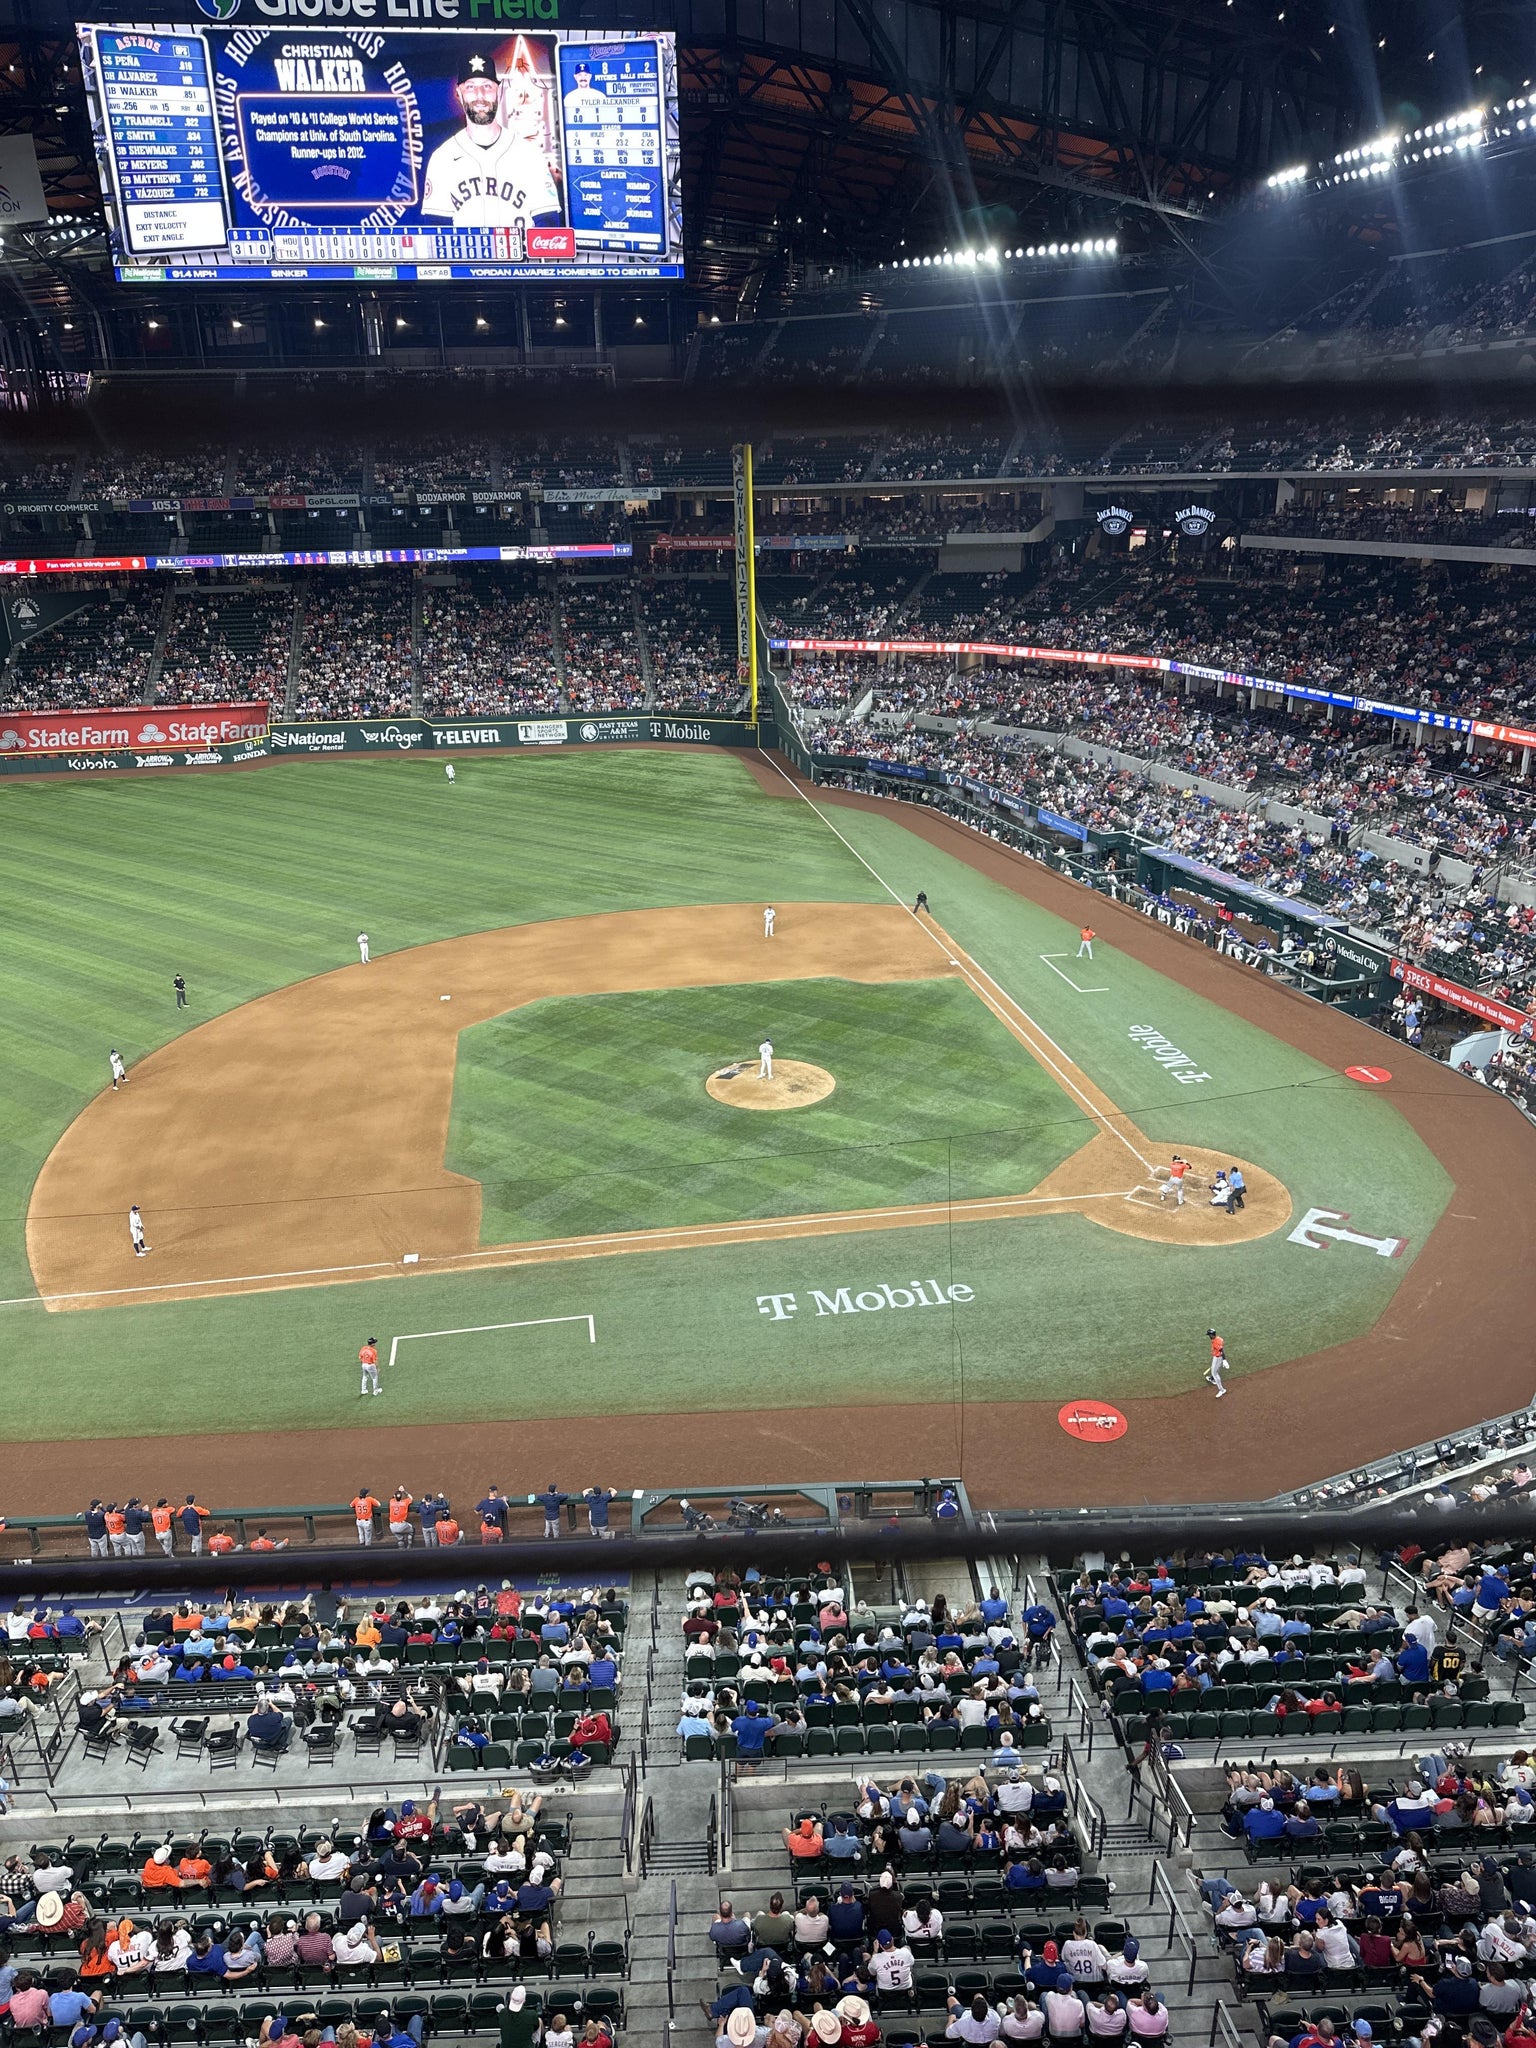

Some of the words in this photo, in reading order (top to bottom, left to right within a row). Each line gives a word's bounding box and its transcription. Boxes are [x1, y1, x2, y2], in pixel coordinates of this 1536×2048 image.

[254, 0, 377, 18] Globe
[386, 0, 460, 19] Life
[471, 0, 559, 20] Field
[115, 35, 161, 54] ASTROS
[281, 44, 353, 58] CHRISTIAN
[102, 56, 112, 65] SS
[115, 55, 140, 67] PEÑA
[118, 71, 158, 82] ALVAREZ
[273, 58, 366, 93] WALKER
[107, 86, 117, 95] 1B
[120, 87, 158, 97] WALKER
[122, 101, 138, 111] .256
[161, 103, 170, 112] 15
[196, 104, 205, 113] 40
[581, 98, 601, 106] TYLER
[602, 98, 641, 106] ALEXANDER
[124, 116, 174, 127] TRAMMELL
[251, 111, 277, 127] Played
[278, 115, 288, 125] on
[301, 112, 309, 125] &
[319, 111, 347, 127] College
[348, 112, 372, 125] World
[373, 113, 398, 126] Series
[126, 130, 156, 141] SMITH
[256, 129, 299, 144] Champions
[300, 130, 309, 142] at
[309, 129, 329, 142] Univ.
[329, 129, 338, 142] of
[339, 130, 361, 143] South
[362, 129, 397, 143] Carolina.
[129, 145, 177, 156] SHEWMAKE
[291, 146, 338, 160] Runner-ups
[339, 146, 346, 158] in
[347, 146, 366, 159] 2012.
[131, 160, 168, 170] MEYERS
[133, 174, 182, 184] MATTHEWS
[135, 187, 175, 198] VÁZQUEZ
[450, 176, 527, 211] ASTROS
[143, 210, 178, 219] DISTANCE
[136, 223, 152, 231] EXIT
[154, 221, 187, 230] VELOCITY
[143, 235, 160, 243] EXIT
[161, 233, 184, 242] ANGLE
[282, 237, 298, 246] HOU
[235, 244, 242, 255] 3
[260, 244, 266, 255] 0
[286, 249, 299, 258] TEX
[171, 270, 193, 279] 91.4
[193, 269, 218, 279] MPH
[271, 269, 309, 278] SINKER
[419, 269, 437, 277] LAST
[438, 269, 449, 277] AB
[469, 268, 513, 277] YORDAN
[512, 268, 557, 277] ALVAREZ
[557, 268, 605, 277] HOMERED
[606, 268, 620, 277] TO
[621, 268, 661, 277] CENTER
[308, 496, 357, 507] GoPGL.com
[369, 496, 392, 505] PGL
[416, 492, 466, 503] BODYARMOR
[472, 491, 522, 501] BODYARMOR
[546, 490, 570, 503] Blue
[574, 489, 601, 502] Mint
[605, 489, 629, 501] Thai
[17, 503, 51, 513] PRIORITY
[53, 502, 99, 512] COMMERCE
[151, 499, 181, 511] 105.3
[184, 499, 206, 510] THE
[208, 499, 230, 509] FAN
[280, 498, 303, 507] PGL
[1096, 508, 1111, 523] JACK
[1111, 505, 1134, 523] DANIEL'S
[1175, 508, 1191, 523] JACK
[1191, 504, 1217, 523] DANIEL'S
[83, 561, 104, 569] thirsty
[156, 558, 175, 566] ALL
[184, 557, 214, 565] TEXAS
[609, 727, 628, 735] A&M
[664, 723, 711, 741] Mobile
[252, 737, 265, 746] 374
[288, 731, 347, 746] National
[380, 725, 424, 750] Kroger
[145, 754, 168, 763] ARROW
[193, 753, 217, 762] ARROW
[232, 749, 268, 763] HONDA
[67, 758, 119, 771] Kubota
[965, 780, 981, 793] American
[1336, 943, 1363, 967] Medical
[1363, 954, 1380, 974] City
[1406, 969, 1431, 989] SPEC'S
[1433, 983, 1449, 996] Official
[1448, 989, 1462, 1002] Liquor
[1461, 994, 1473, 1007] Store
[1473, 999, 1478, 1008] of
[1478, 1002, 1486, 1013] the
[1485, 1004, 1498, 1018] Texas
[1498, 1011, 1516, 1026] Rangers
[1128, 1024, 1198, 1070] Mobile
[806, 1279, 976, 1317] Mobile
[357, 1504, 369, 1515] 35
[537, 1576, 561, 1586] Field
[477, 1599, 489, 1609] 27
[1517, 1771, 1526, 1783] 5
[398, 1822, 424, 1836] LANGFORD
[118, 1951, 141, 1968] 44
[1074, 1959, 1093, 1974] 48
[890, 1970, 901, 1986] 5
